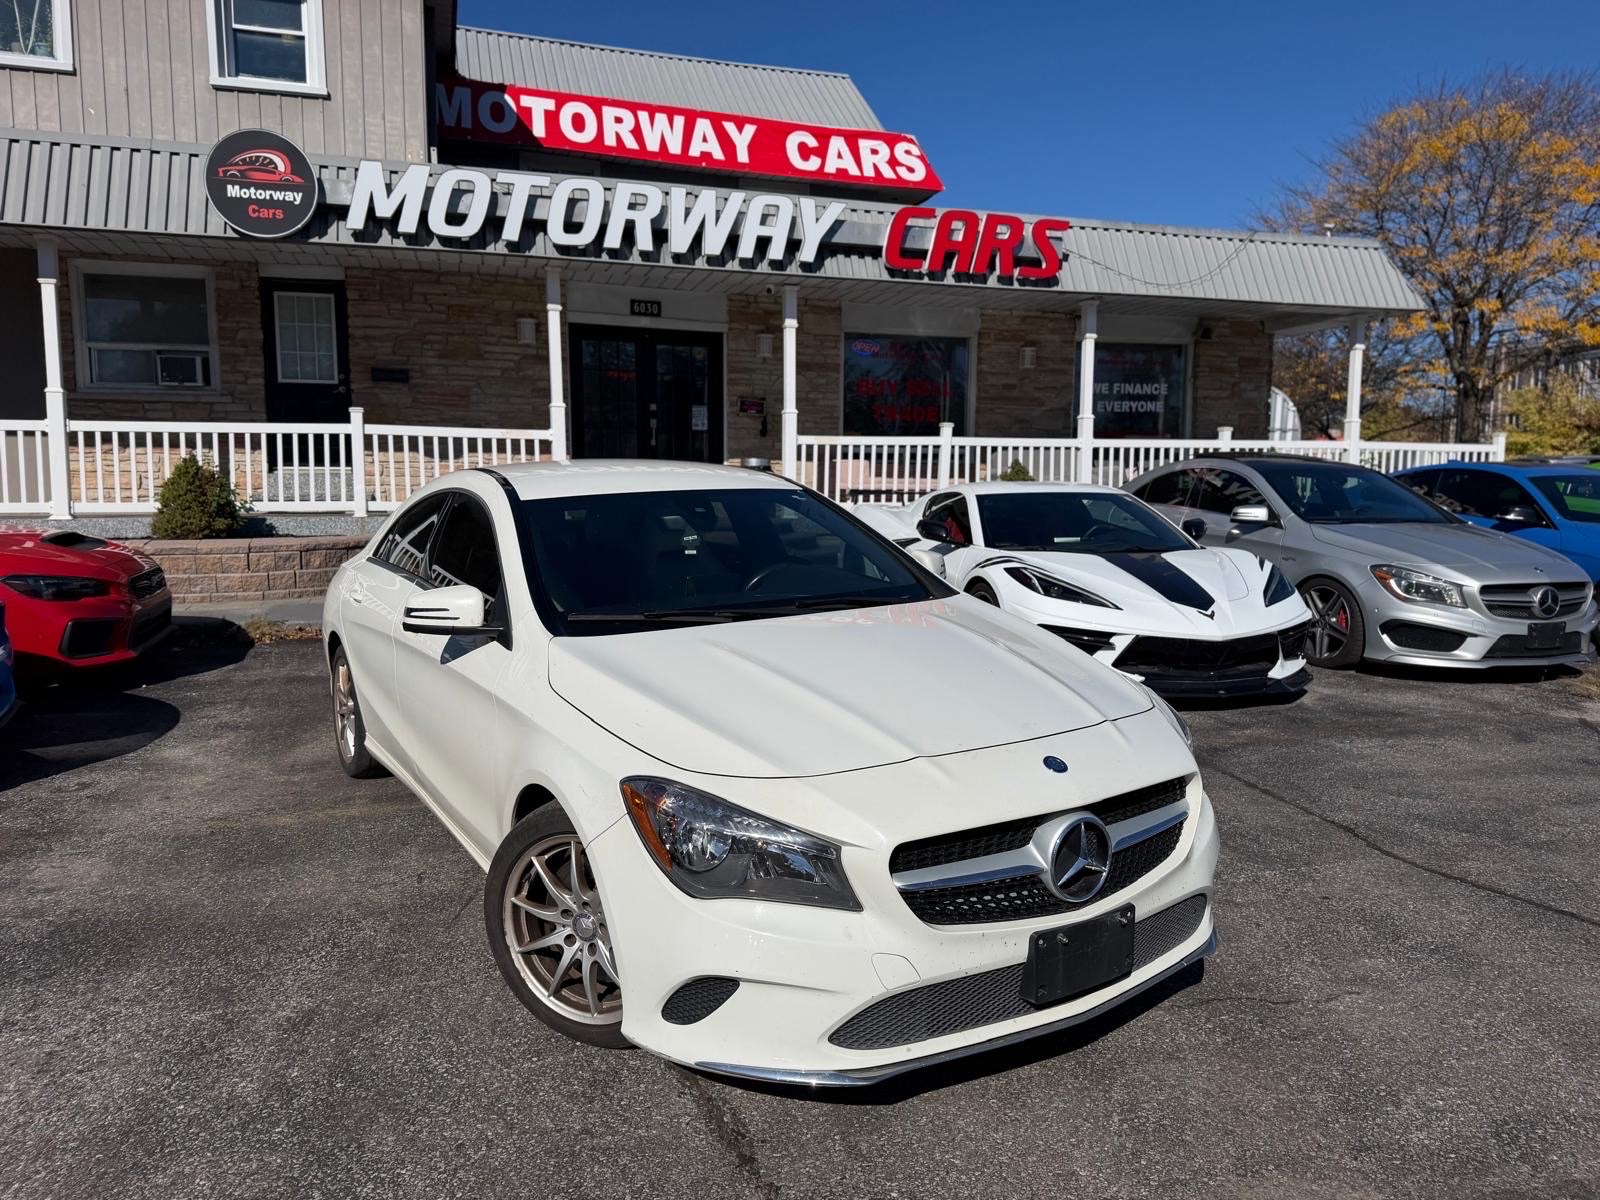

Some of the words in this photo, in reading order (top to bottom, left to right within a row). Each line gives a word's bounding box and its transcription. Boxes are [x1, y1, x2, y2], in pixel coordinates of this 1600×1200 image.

[436, 83, 757, 164] MOTORWAY
[785, 131, 927, 182] CARS
[226, 184, 303, 205] Motorway
[248, 204, 284, 219] Cars
[345, 159, 847, 264] MOTORWAY
[884, 206, 1070, 280] CARS
[633, 302, 658, 315] 6030
[852, 340, 880, 353] OPEN
[1112, 383, 1169, 396] FINANCE
[1096, 400, 1165, 413] EVERYONE
